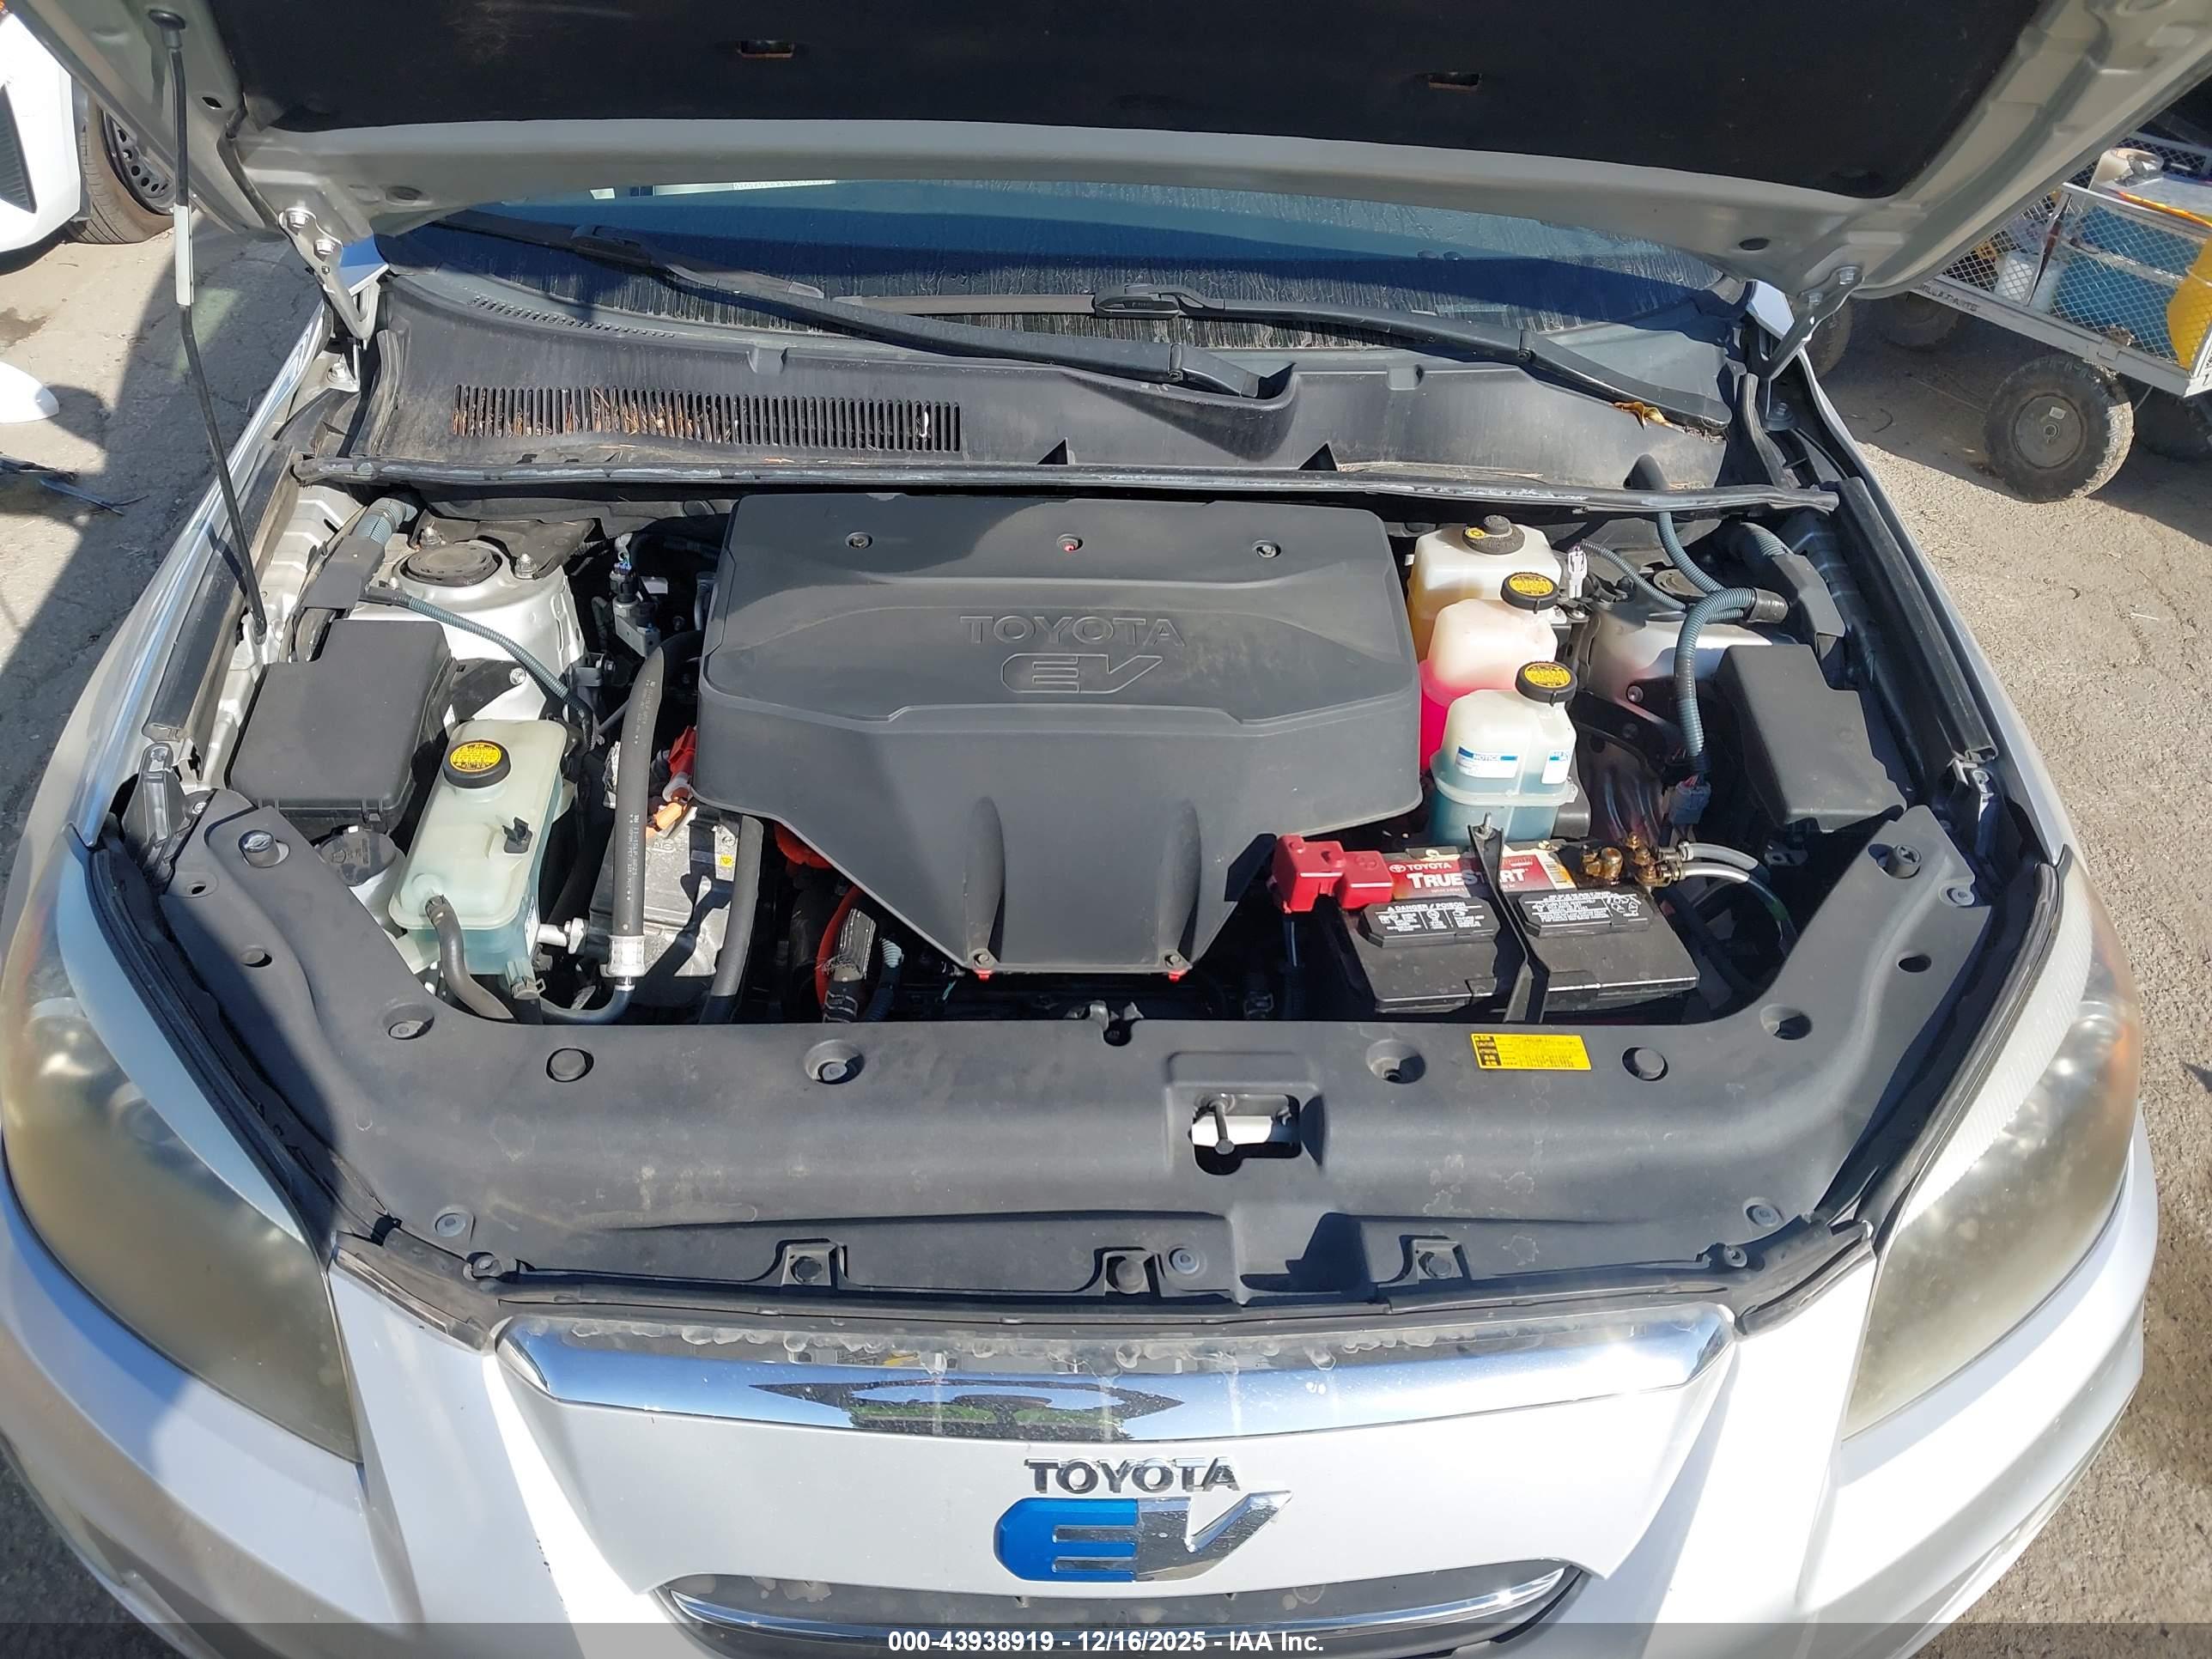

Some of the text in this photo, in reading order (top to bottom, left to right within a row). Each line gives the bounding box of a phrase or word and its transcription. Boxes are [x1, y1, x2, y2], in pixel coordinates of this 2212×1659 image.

[959, 615, 1186, 646] TOYOTA
[1000, 653, 1164, 694] EV
[1407, 862, 1452, 871] TOYOTA
[1395, 903, 1429, 912] DANGER
[1024, 1456, 1241, 1494] TOYOTA
[994, 1490, 1293, 1583] EV
